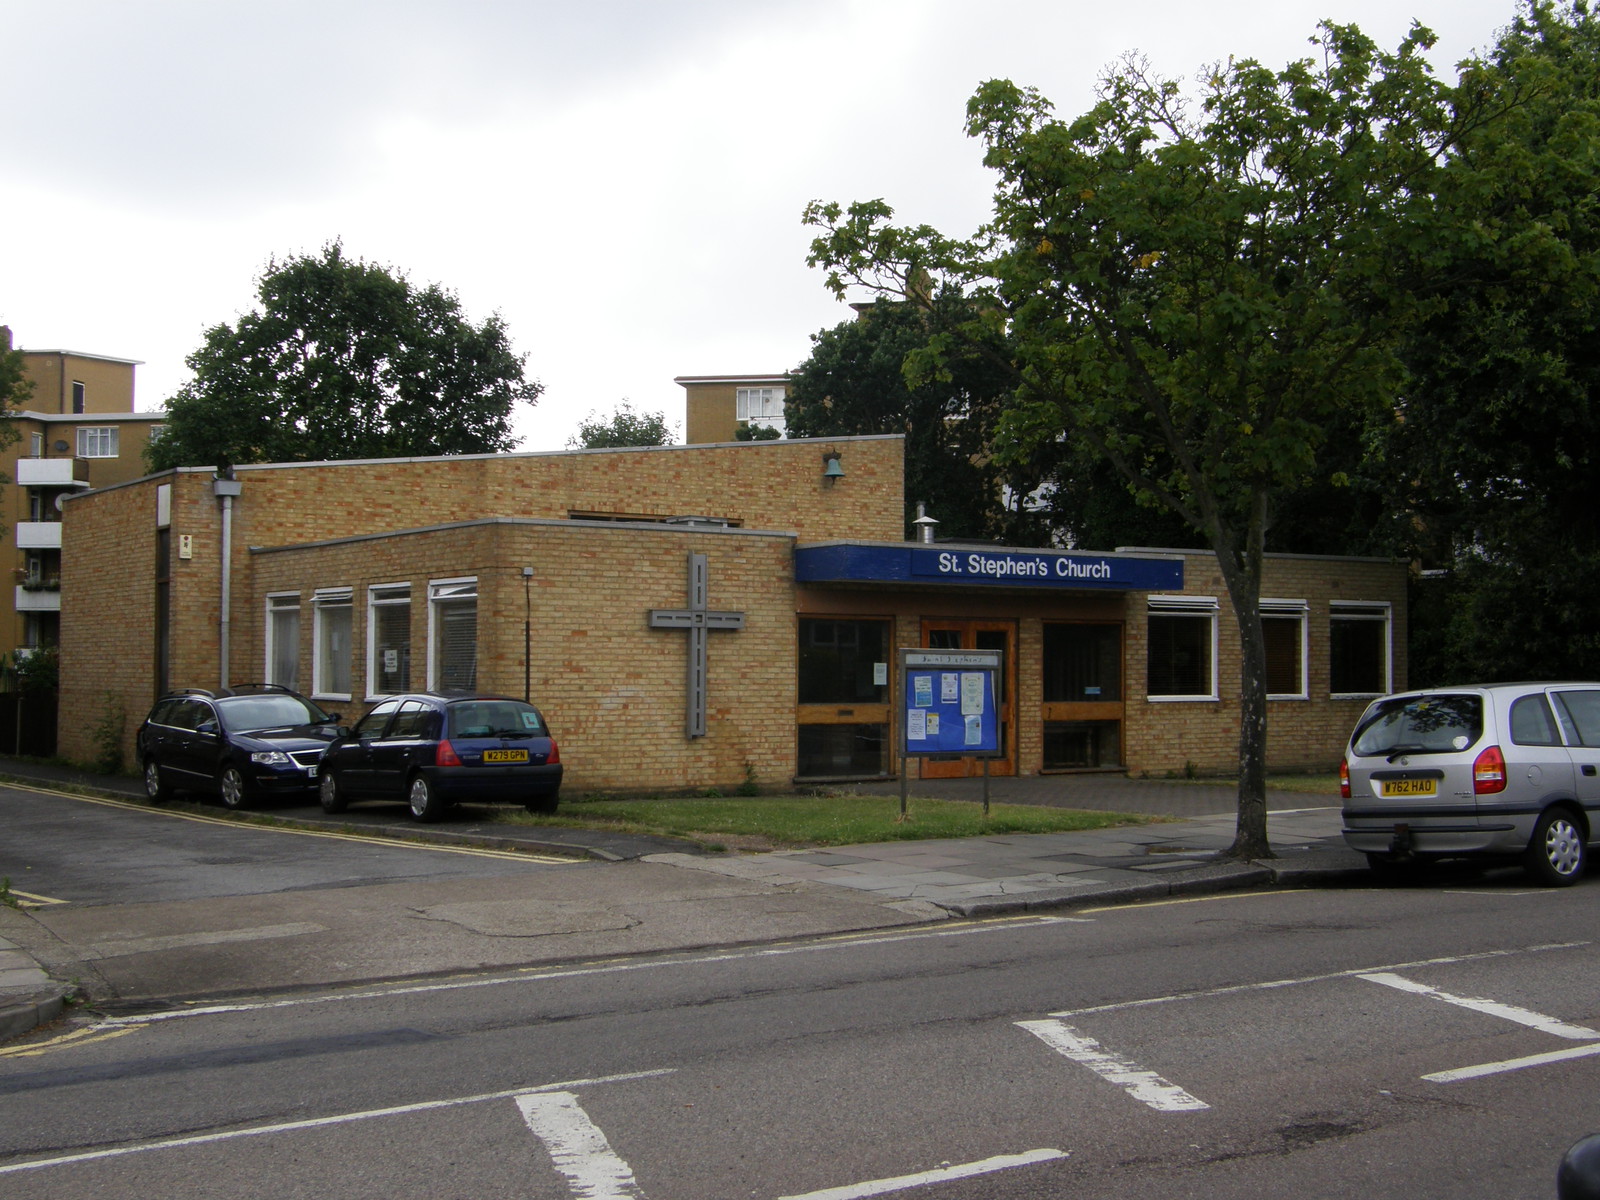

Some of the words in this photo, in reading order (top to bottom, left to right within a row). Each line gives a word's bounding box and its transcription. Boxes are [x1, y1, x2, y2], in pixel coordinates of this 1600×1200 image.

[938, 552, 962, 573] St.
[967, 554, 1048, 578] Stephen's
[1055, 557, 1111, 579] Church
[487, 750, 509, 760] W279
[510, 750, 525, 760] GPN
[1385, 781, 1410, 793] W762
